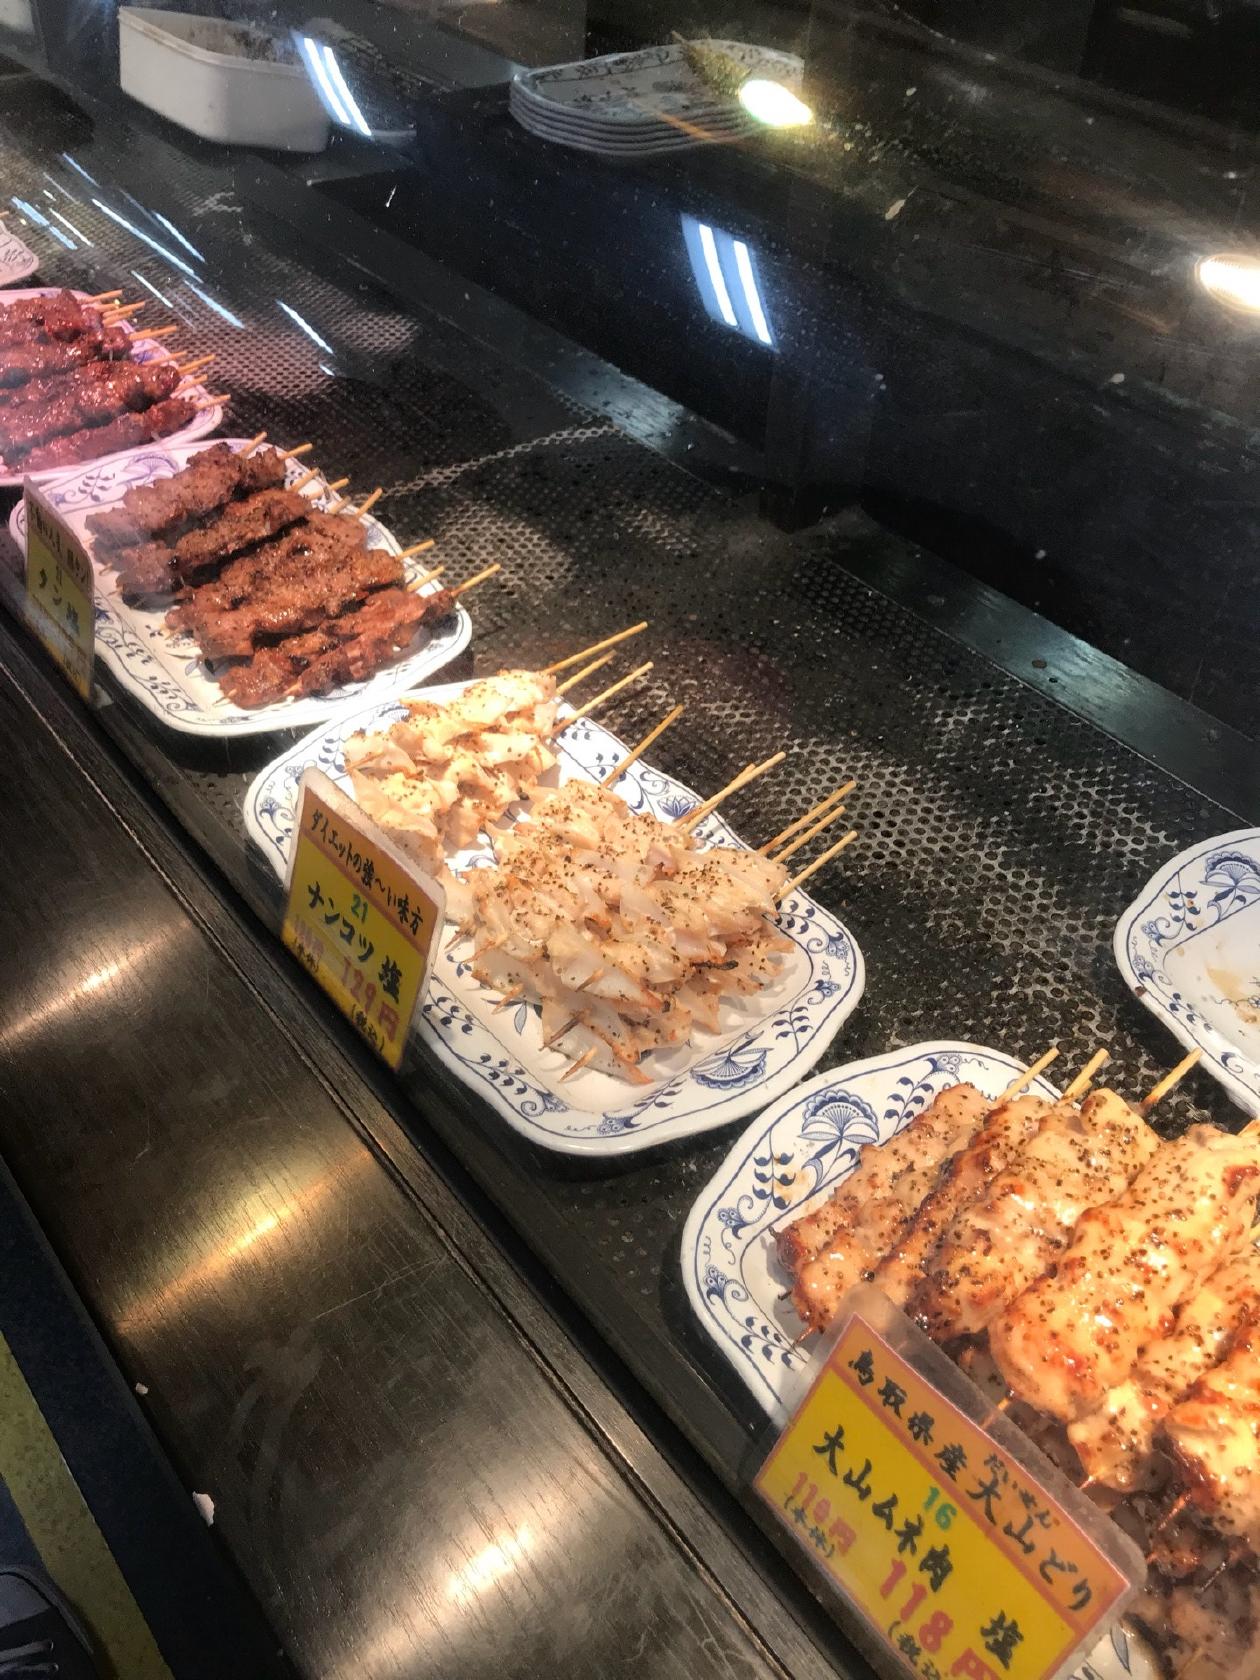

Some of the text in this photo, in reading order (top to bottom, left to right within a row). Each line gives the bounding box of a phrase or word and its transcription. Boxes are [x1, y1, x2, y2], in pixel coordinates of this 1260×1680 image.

[307, 881, 375, 963] ナンコツ
[351, 894, 369, 924] 21
[341, 955, 401, 1042] 129円
[848, 1348, 1093, 1612] 鳥取県産大山どり
[922, 1485, 958, 1532] 16
[812, 1424, 1025, 1671] 大山ムネ肉 塩
